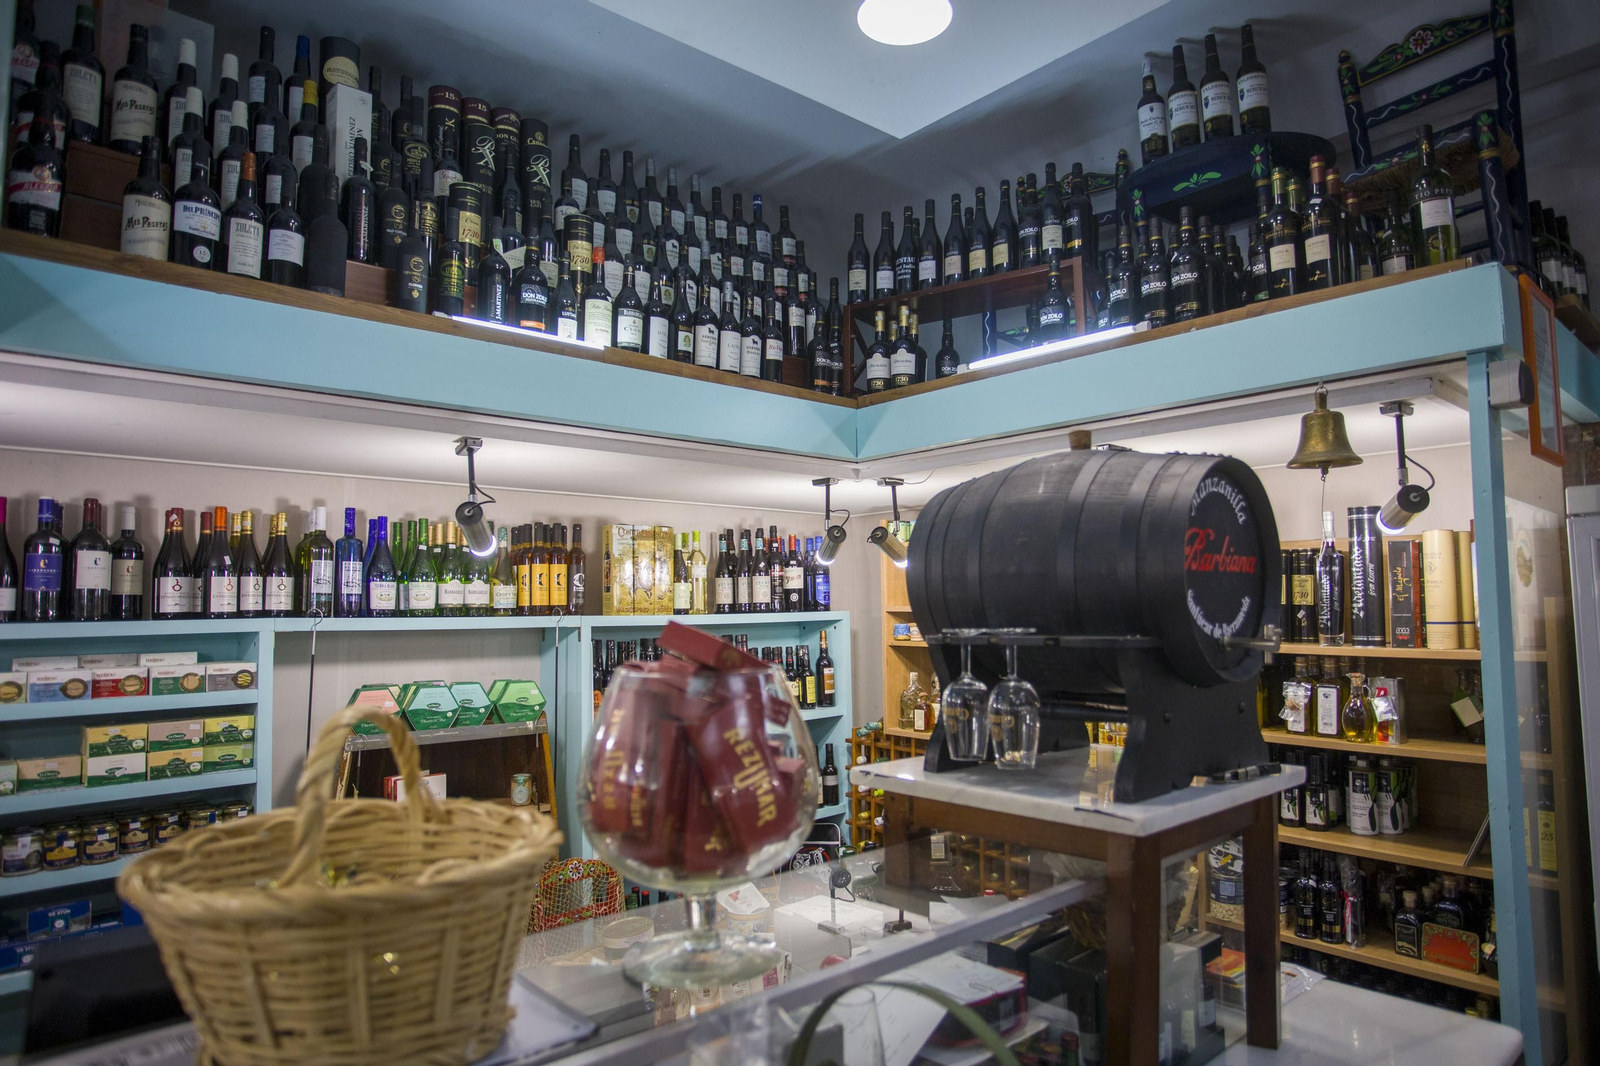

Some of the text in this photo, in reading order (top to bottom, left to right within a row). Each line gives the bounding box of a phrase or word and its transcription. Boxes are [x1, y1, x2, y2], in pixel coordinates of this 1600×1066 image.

[1414, 190, 1430, 200] TIO
[462, 228, 480, 240] 1730
[570, 254, 590, 264] 1730
[1252, 264, 1265, 272] DON
[1150, 281, 1166, 289] ZOILO
[1190, 476, 1247, 525] Manzanilla
[1184, 527, 1256, 575] Barbiana
[1352, 546, 1364, 618] Adelantado
[1318, 574, 1331, 627] Adelantado
[722, 728, 778, 828] REZUMAR
